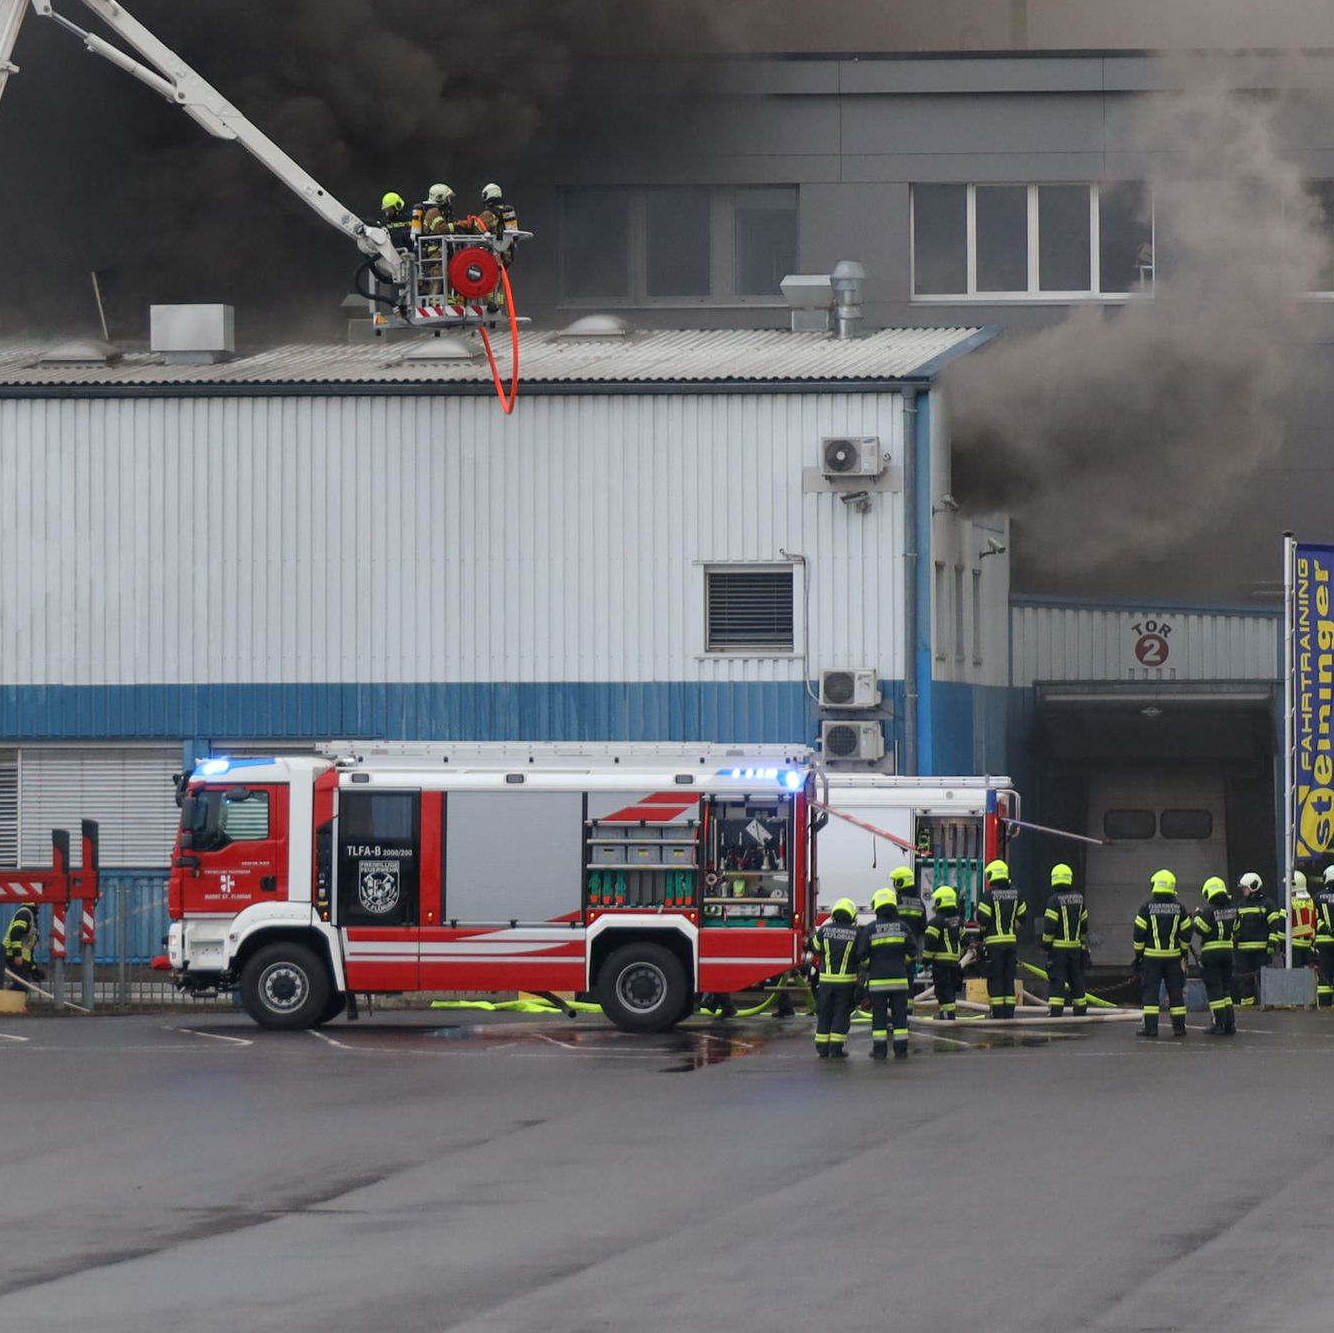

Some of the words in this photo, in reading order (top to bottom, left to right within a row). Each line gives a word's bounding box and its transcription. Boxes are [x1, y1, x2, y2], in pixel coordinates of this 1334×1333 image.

[1131, 620, 1172, 638] TOR
[1143, 639, 1161, 661] 2
[1298, 558, 1313, 771] FAHRTRAINING
[347, 846, 381, 856] TLFA-B
[382, 849, 413, 857] 2000/200
